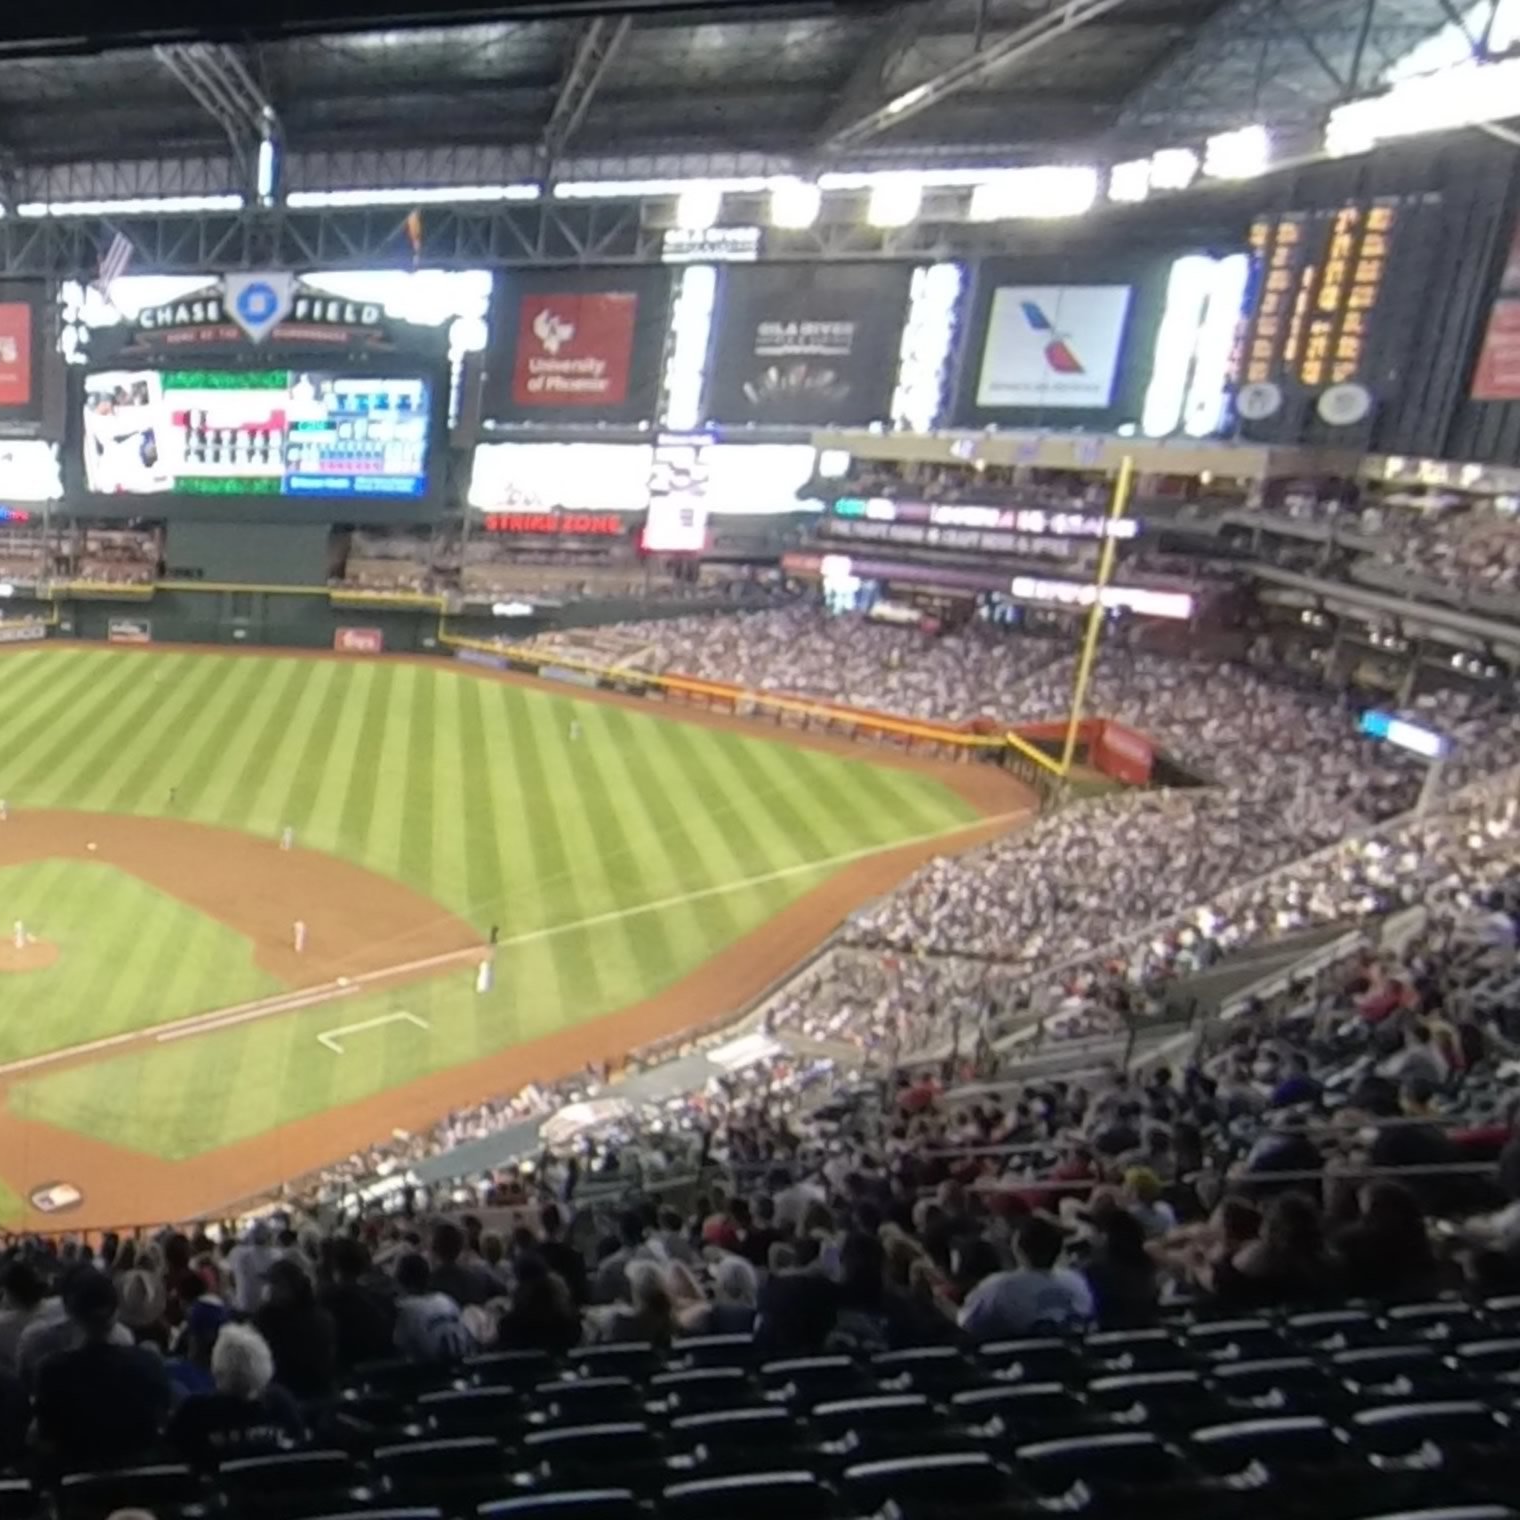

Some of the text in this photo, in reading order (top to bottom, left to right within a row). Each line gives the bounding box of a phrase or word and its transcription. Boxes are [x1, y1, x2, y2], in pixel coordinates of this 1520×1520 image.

[139, 298, 380, 329] CHASE FIELD
[529, 357, 606, 379] University
[527, 376, 609, 392] of Phoenix
[485, 512, 557, 533] STRIKE
